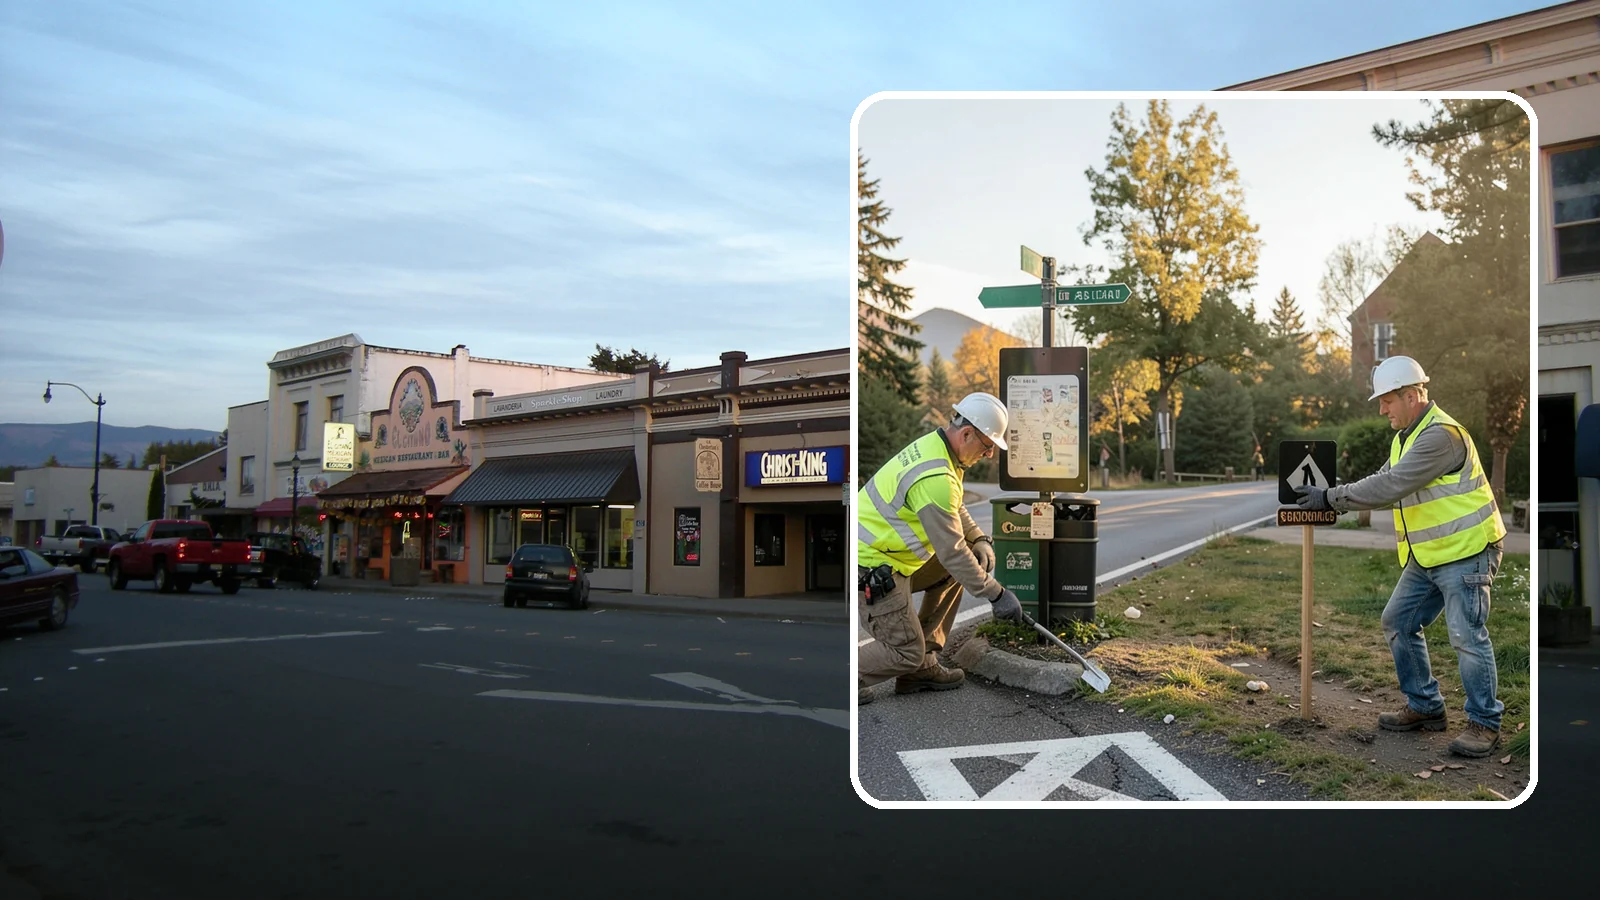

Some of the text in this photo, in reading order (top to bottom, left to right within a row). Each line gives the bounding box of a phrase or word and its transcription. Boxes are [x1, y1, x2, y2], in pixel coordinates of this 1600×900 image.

[493, 402, 522, 412] LAVANDERIA
[561, 394, 583, 405] Shop
[595, 388, 624, 400] LAUNDRY
[397, 451, 433, 463] RESTAURANT
[438, 450, 450, 459] BAR
[760, 450, 828, 478] CHRIST KING
[696, 480, 709, 488] Coffee
